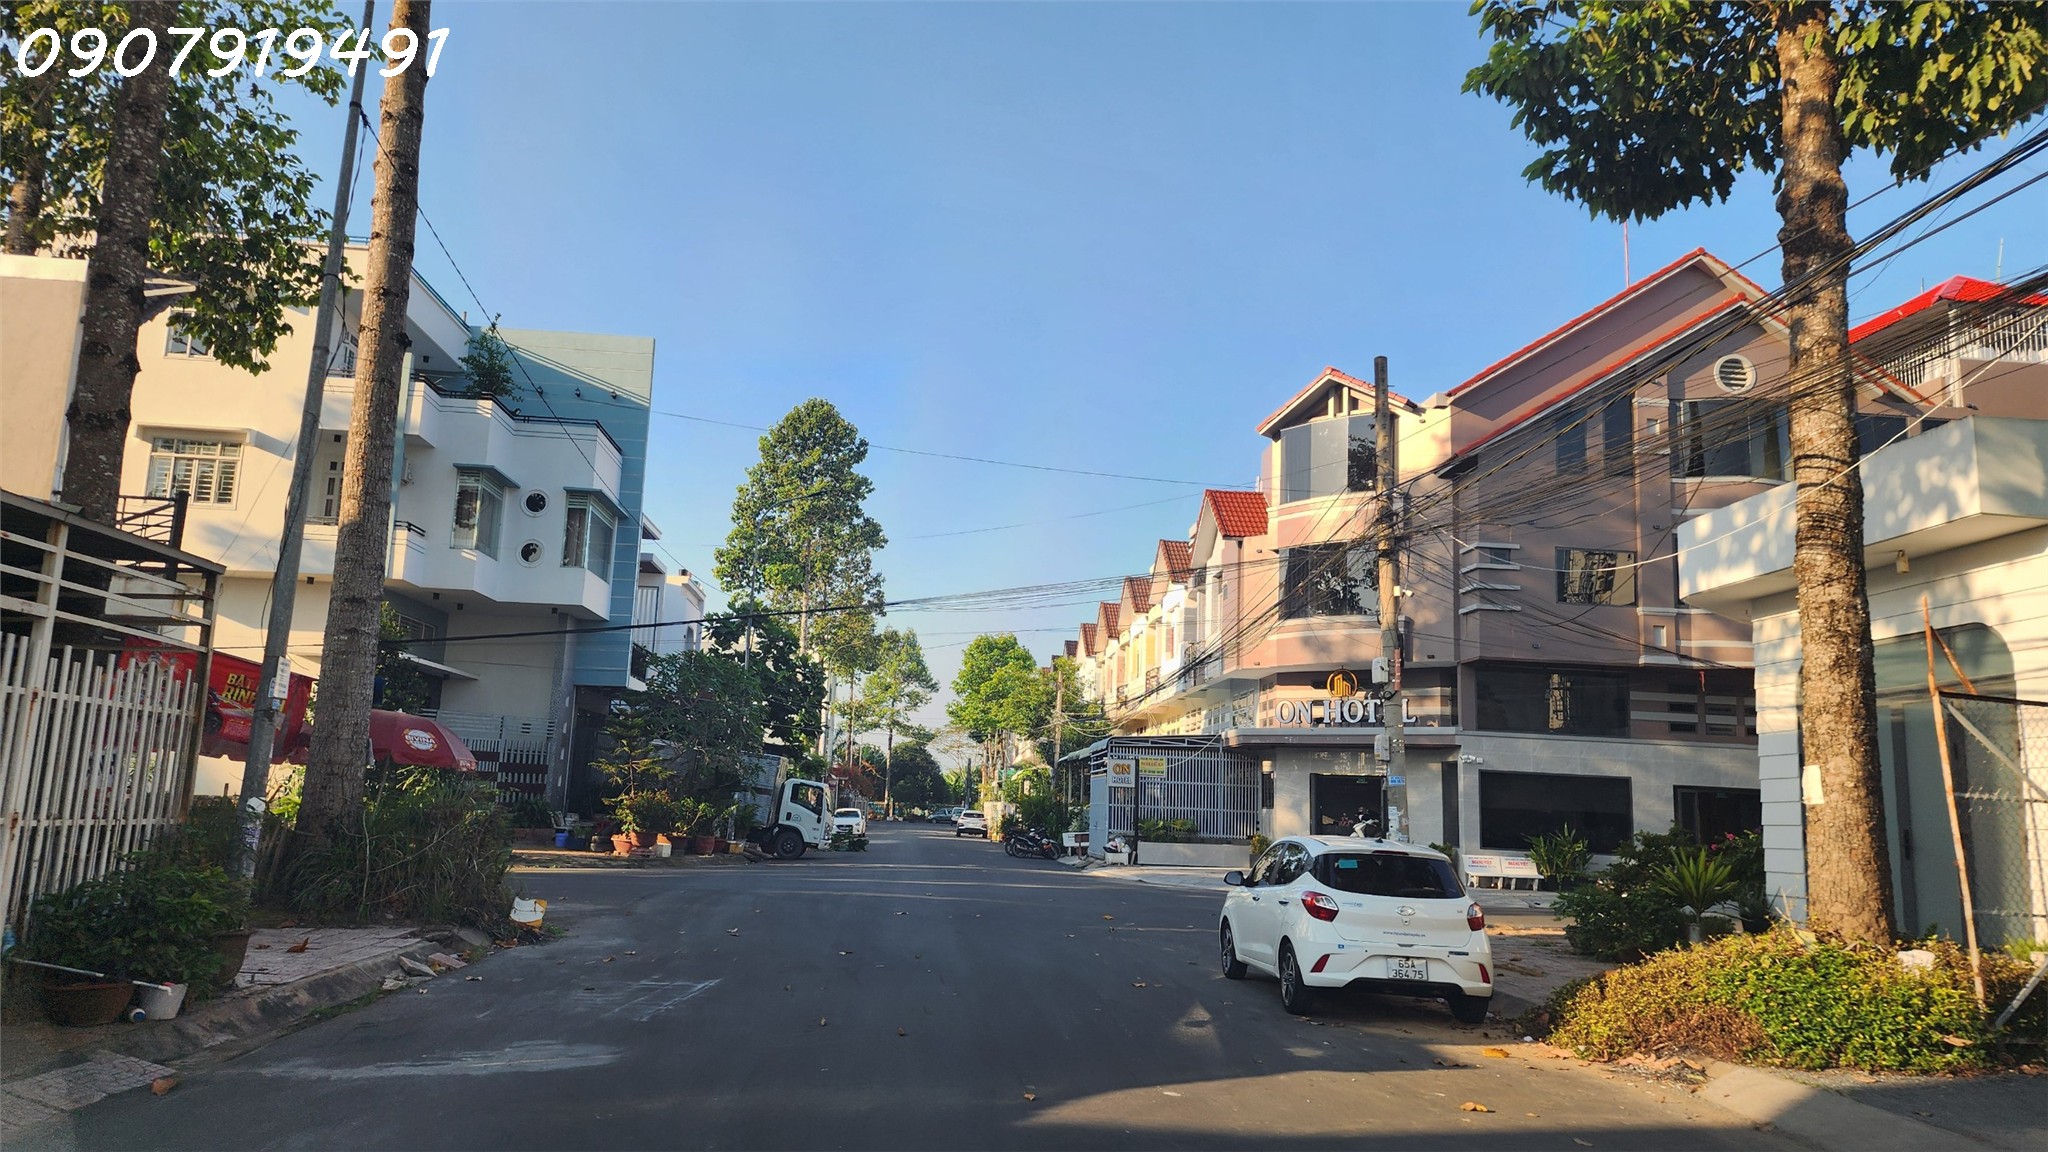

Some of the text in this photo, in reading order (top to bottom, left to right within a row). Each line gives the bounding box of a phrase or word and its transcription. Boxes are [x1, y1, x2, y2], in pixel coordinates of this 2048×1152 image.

[1275, 698, 1418, 724] ON HOTL
[1113, 763, 1131, 775] ON
[1112, 776, 1132, 785] HOTEL
[1398, 959, 1416, 969] 65A
[1392, 969, 1424, 980] 364.75
